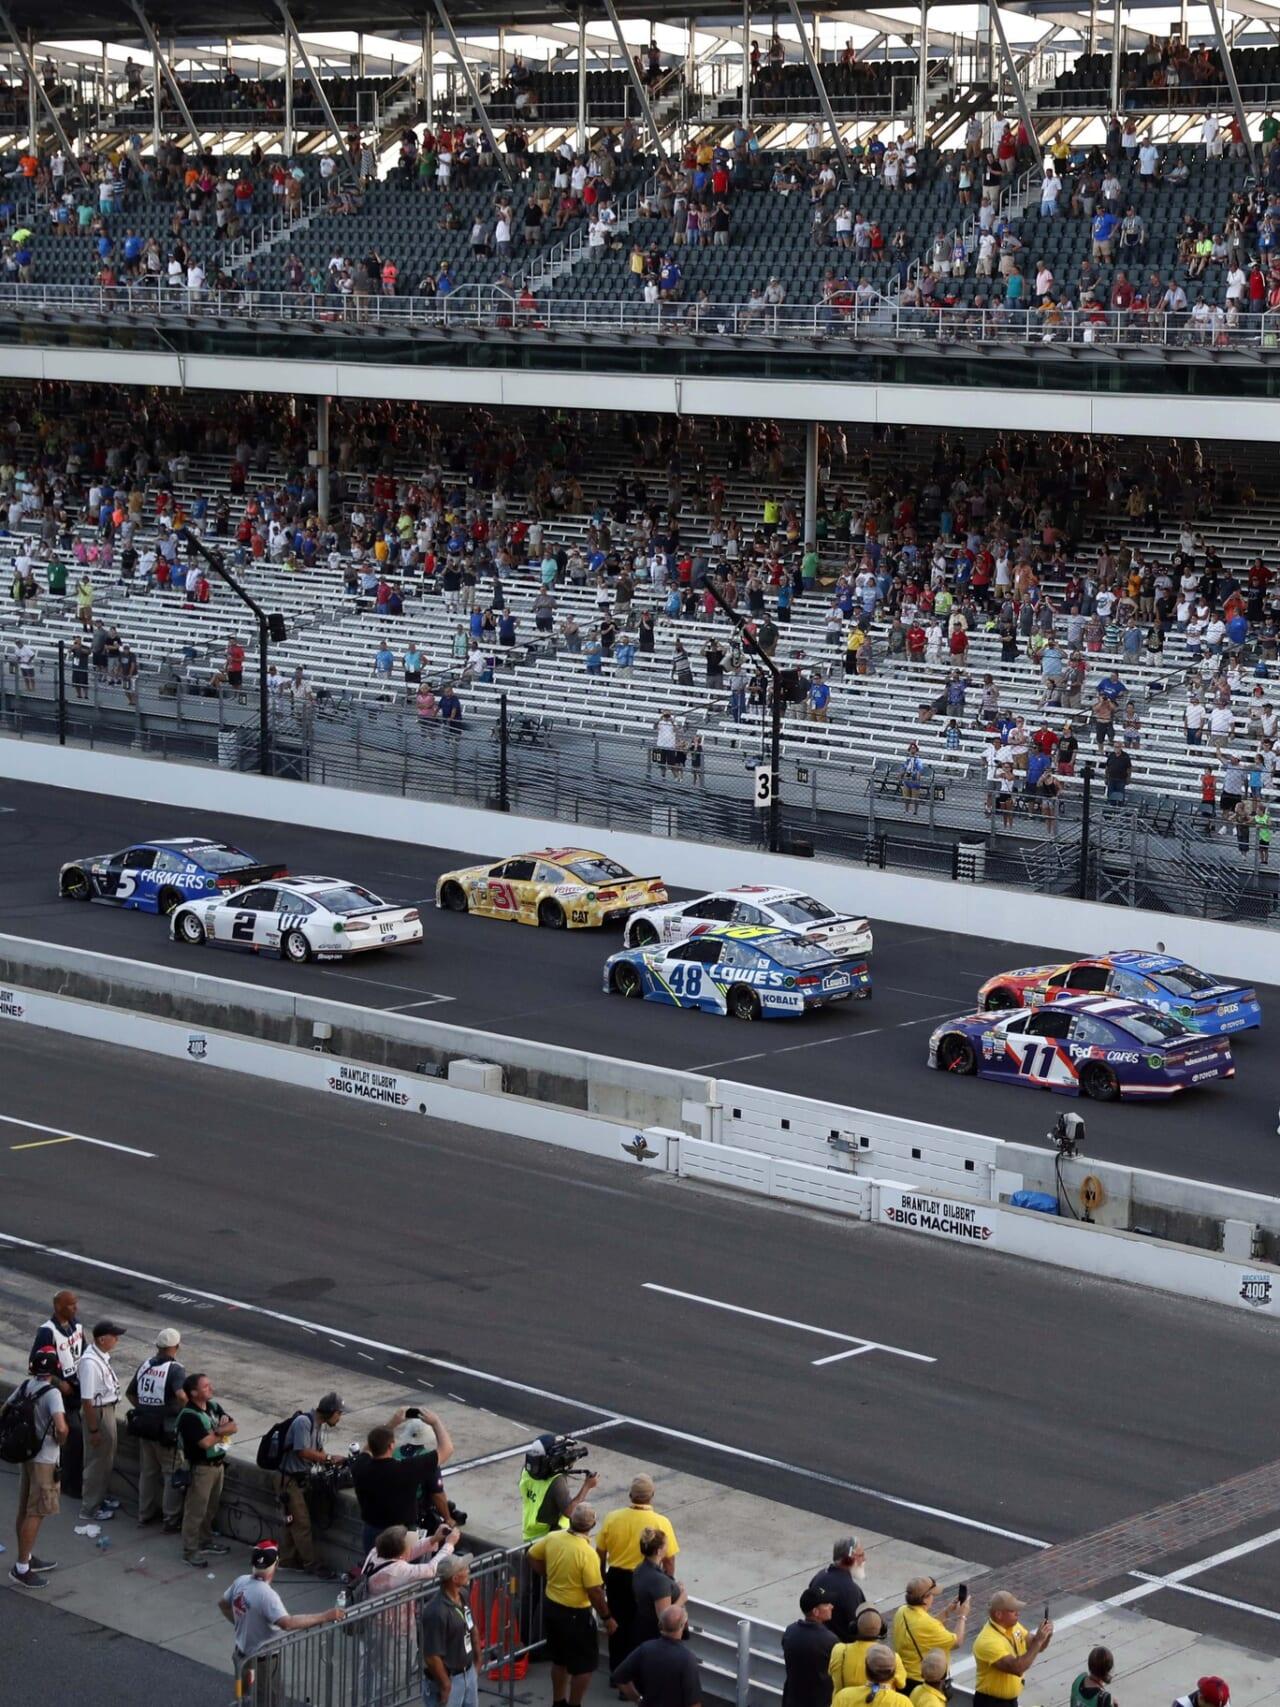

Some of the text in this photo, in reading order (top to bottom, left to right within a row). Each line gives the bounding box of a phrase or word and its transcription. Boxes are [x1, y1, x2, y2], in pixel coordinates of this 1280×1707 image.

[757, 773, 770, 799] 3
[116, 869, 140, 897] 5
[140, 868, 205, 890] FARMERS
[488, 882, 520, 911] 31
[232, 911, 257, 941] 2
[379, 921, 394, 934] Lite
[571, 910, 588, 924] CAT
[668, 962, 703, 998] 48
[709, 963, 784, 987] LOWE'S
[762, 993, 798, 1006] KOBALT
[1021, 1043, 1056, 1079] 11
[1069, 1043, 1105, 1060] FedEx
[340, 1066, 397, 1089] BRANTLEY GILBERT
[335, 1079, 401, 1105] BIG MACHINE
[901, 1195, 976, 1222] BRANTLEY GILBERT
[895, 1209, 981, 1239] BIG MACHINE
[1246, 1283, 1265, 1298] 400
[141, 1377, 155, 1394] 154
